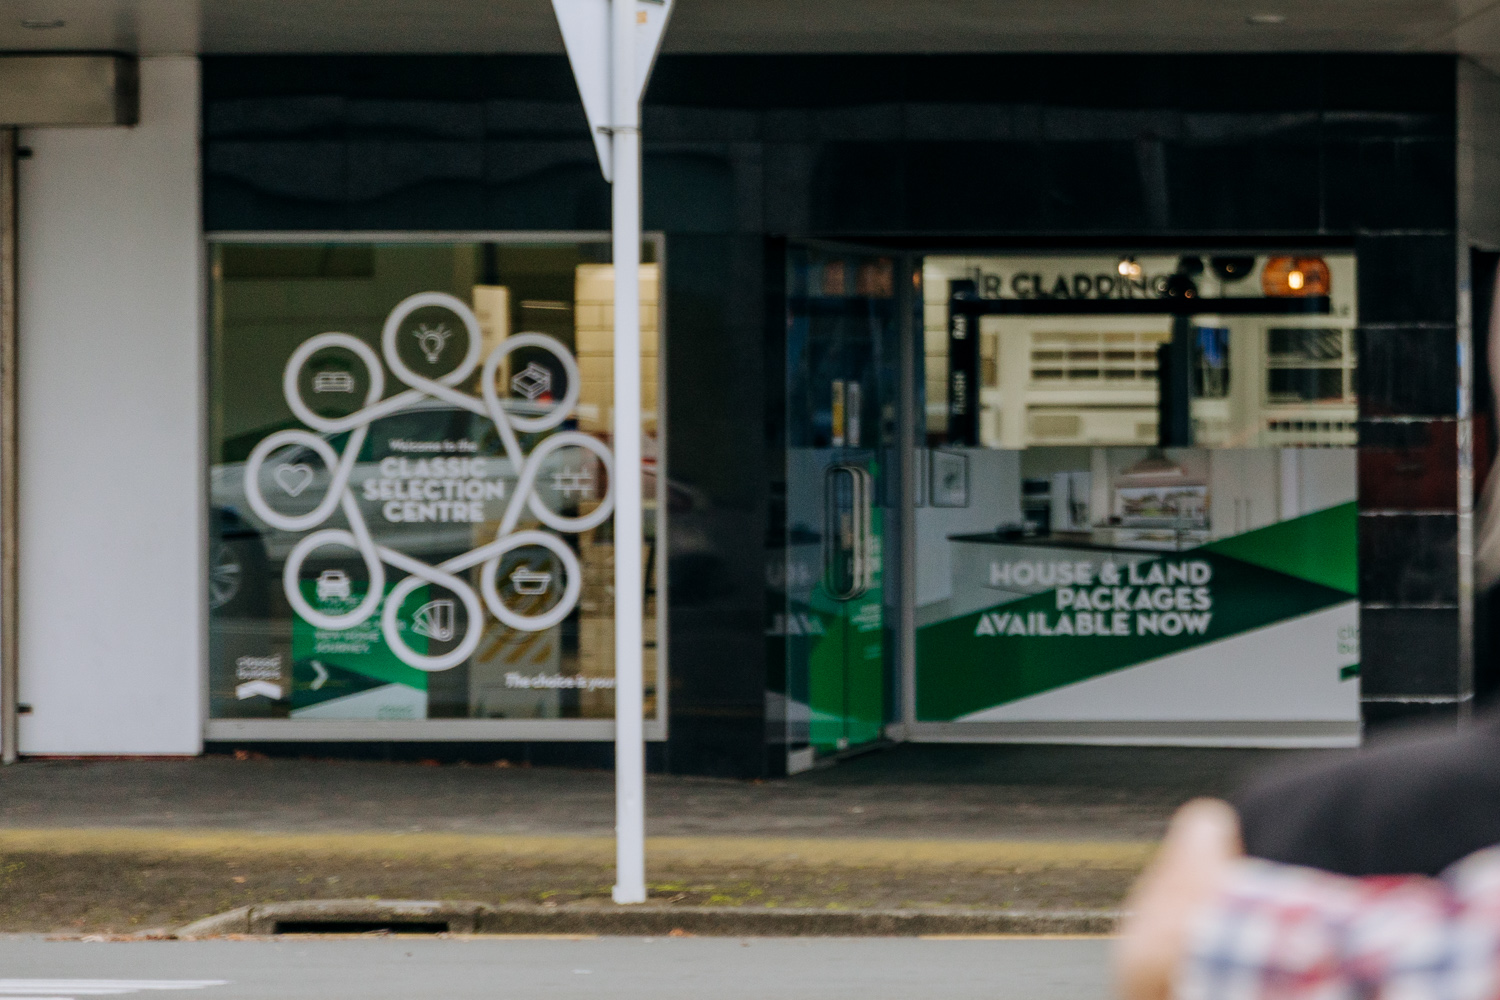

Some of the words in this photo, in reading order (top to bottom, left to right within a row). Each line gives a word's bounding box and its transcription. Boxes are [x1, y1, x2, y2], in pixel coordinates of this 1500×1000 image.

[380, 457, 487, 479] CLASSIC
[363, 479, 505, 501] SELECTION
[382, 501, 485, 523] CENTRE
[989, 561, 1093, 587] HOUSE
[1099, 561, 1122, 587] &
[1128, 561, 1213, 586] LAND
[1056, 586, 1213, 611] PACKAGES
[974, 611, 1131, 637] AVAILABLE
[1136, 611, 1213, 637] NOW
[587, 678, 616, 693] your
